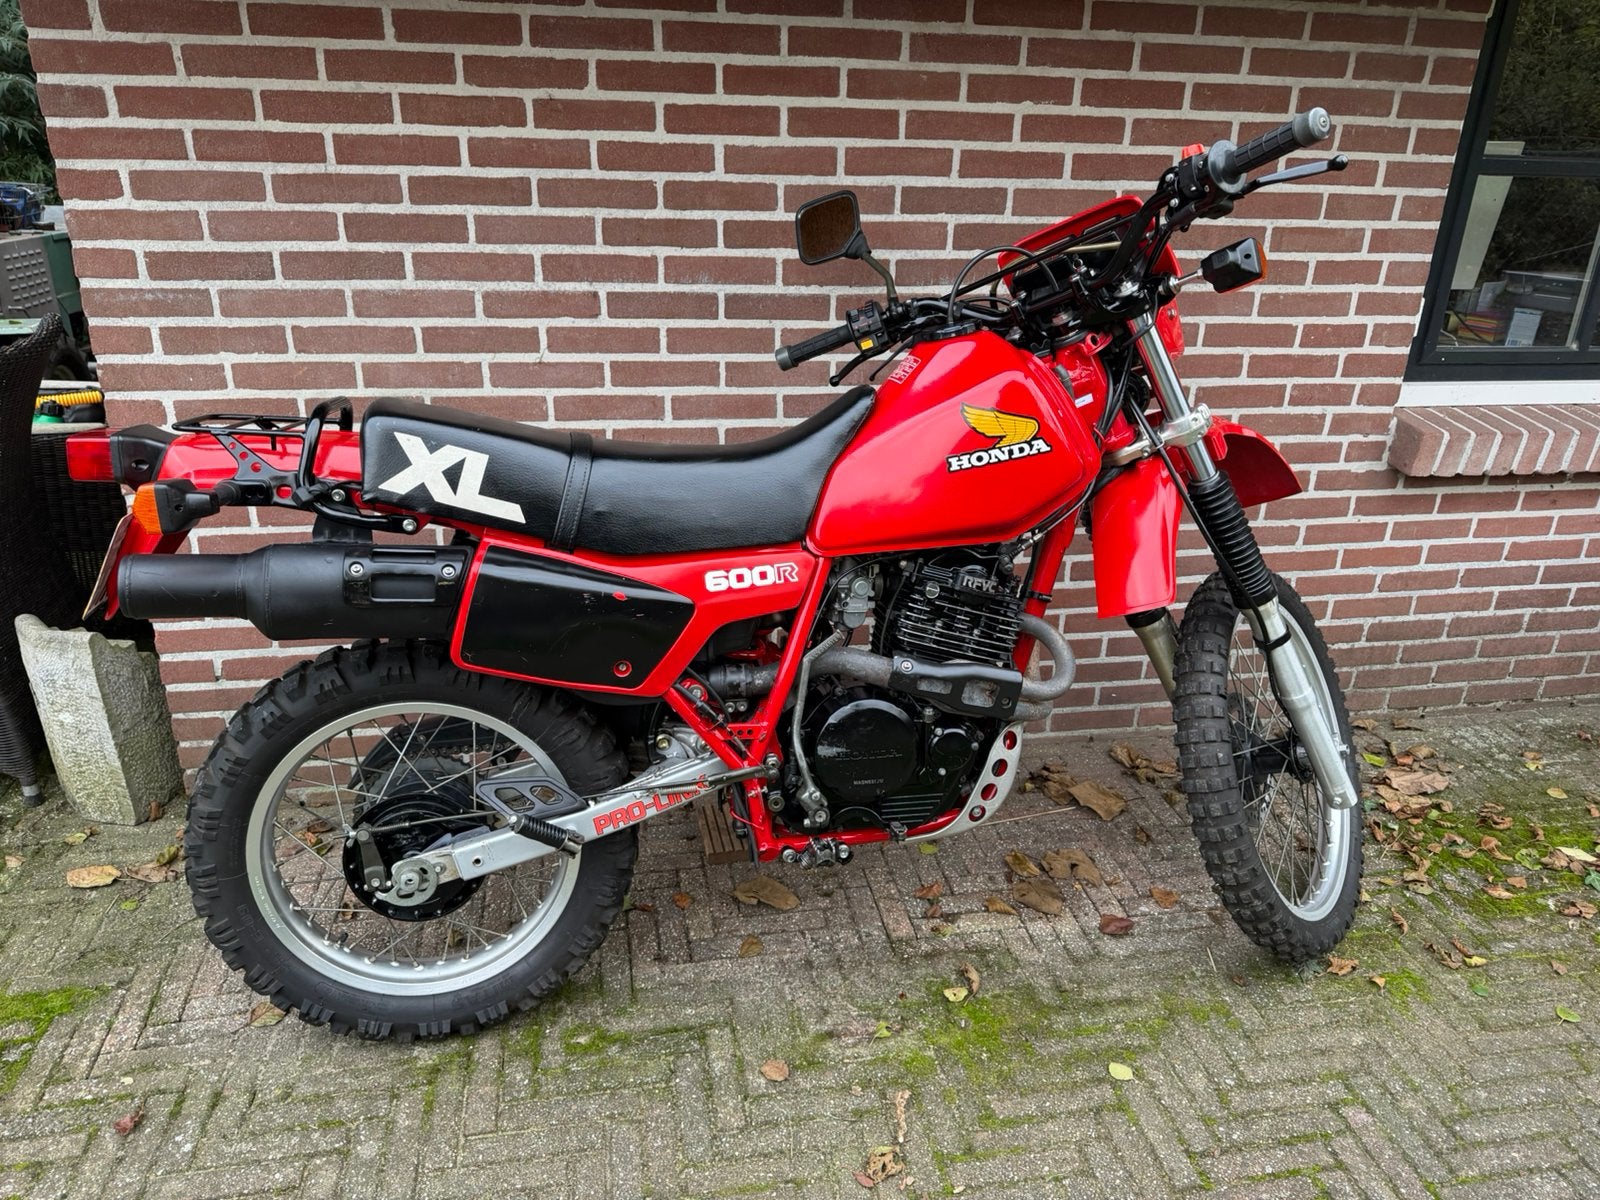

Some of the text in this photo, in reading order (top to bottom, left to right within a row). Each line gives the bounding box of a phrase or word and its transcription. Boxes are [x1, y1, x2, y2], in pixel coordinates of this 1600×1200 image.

[948, 439, 1051, 471] HONDA
[378, 431, 526, 524] XL
[704, 562, 799, 592] 600R
